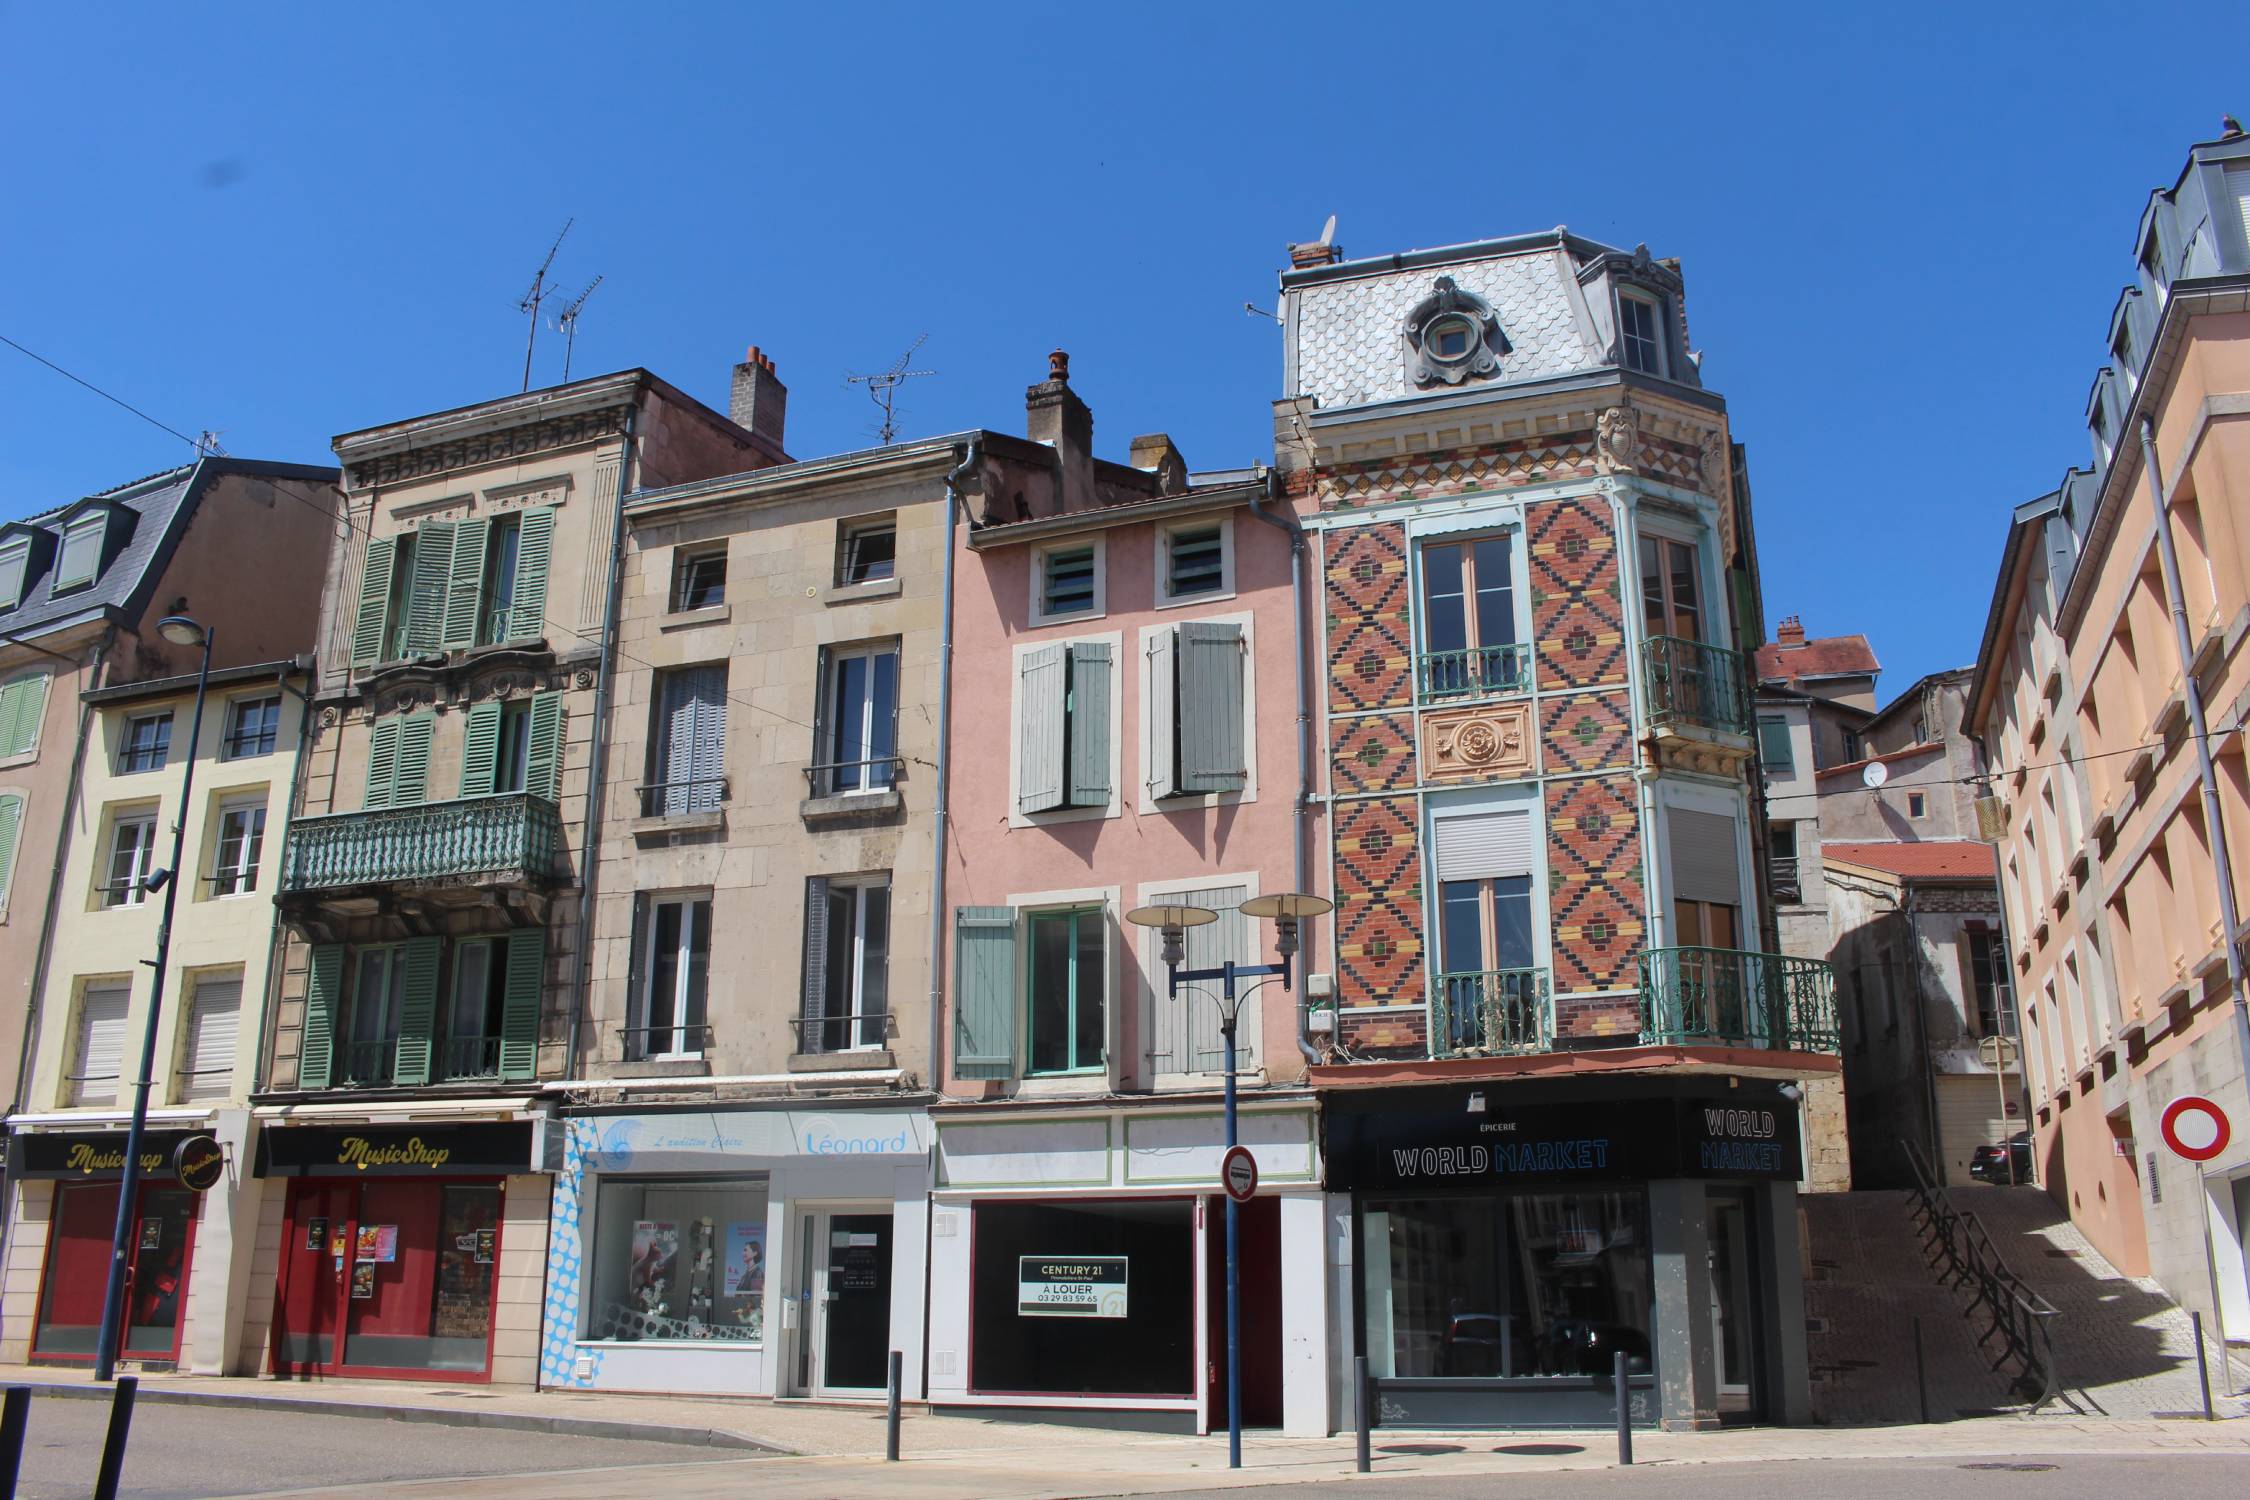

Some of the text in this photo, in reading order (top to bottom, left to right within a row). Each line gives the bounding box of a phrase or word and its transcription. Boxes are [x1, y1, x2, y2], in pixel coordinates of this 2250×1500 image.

[1704, 1108, 1775, 1138] WORLD
[338, 1137, 449, 1170] MusicShop
[807, 1130, 906, 1154] Léonard
[1701, 1142, 1782, 1170] MARKET
[66, 1143, 163, 1174] Musicop
[1393, 1139, 1609, 1176] WORLD MARKET
[1042, 1265, 1091, 1274] CENTURY
[1038, 1294, 1049, 1302] 03
[1050, 1294, 1061, 1302] 29
[1075, 1295, 1086, 1303] 59
[1087, 1295, 1098, 1303] 65
[1053, 1284, 1093, 1294] LOUER
